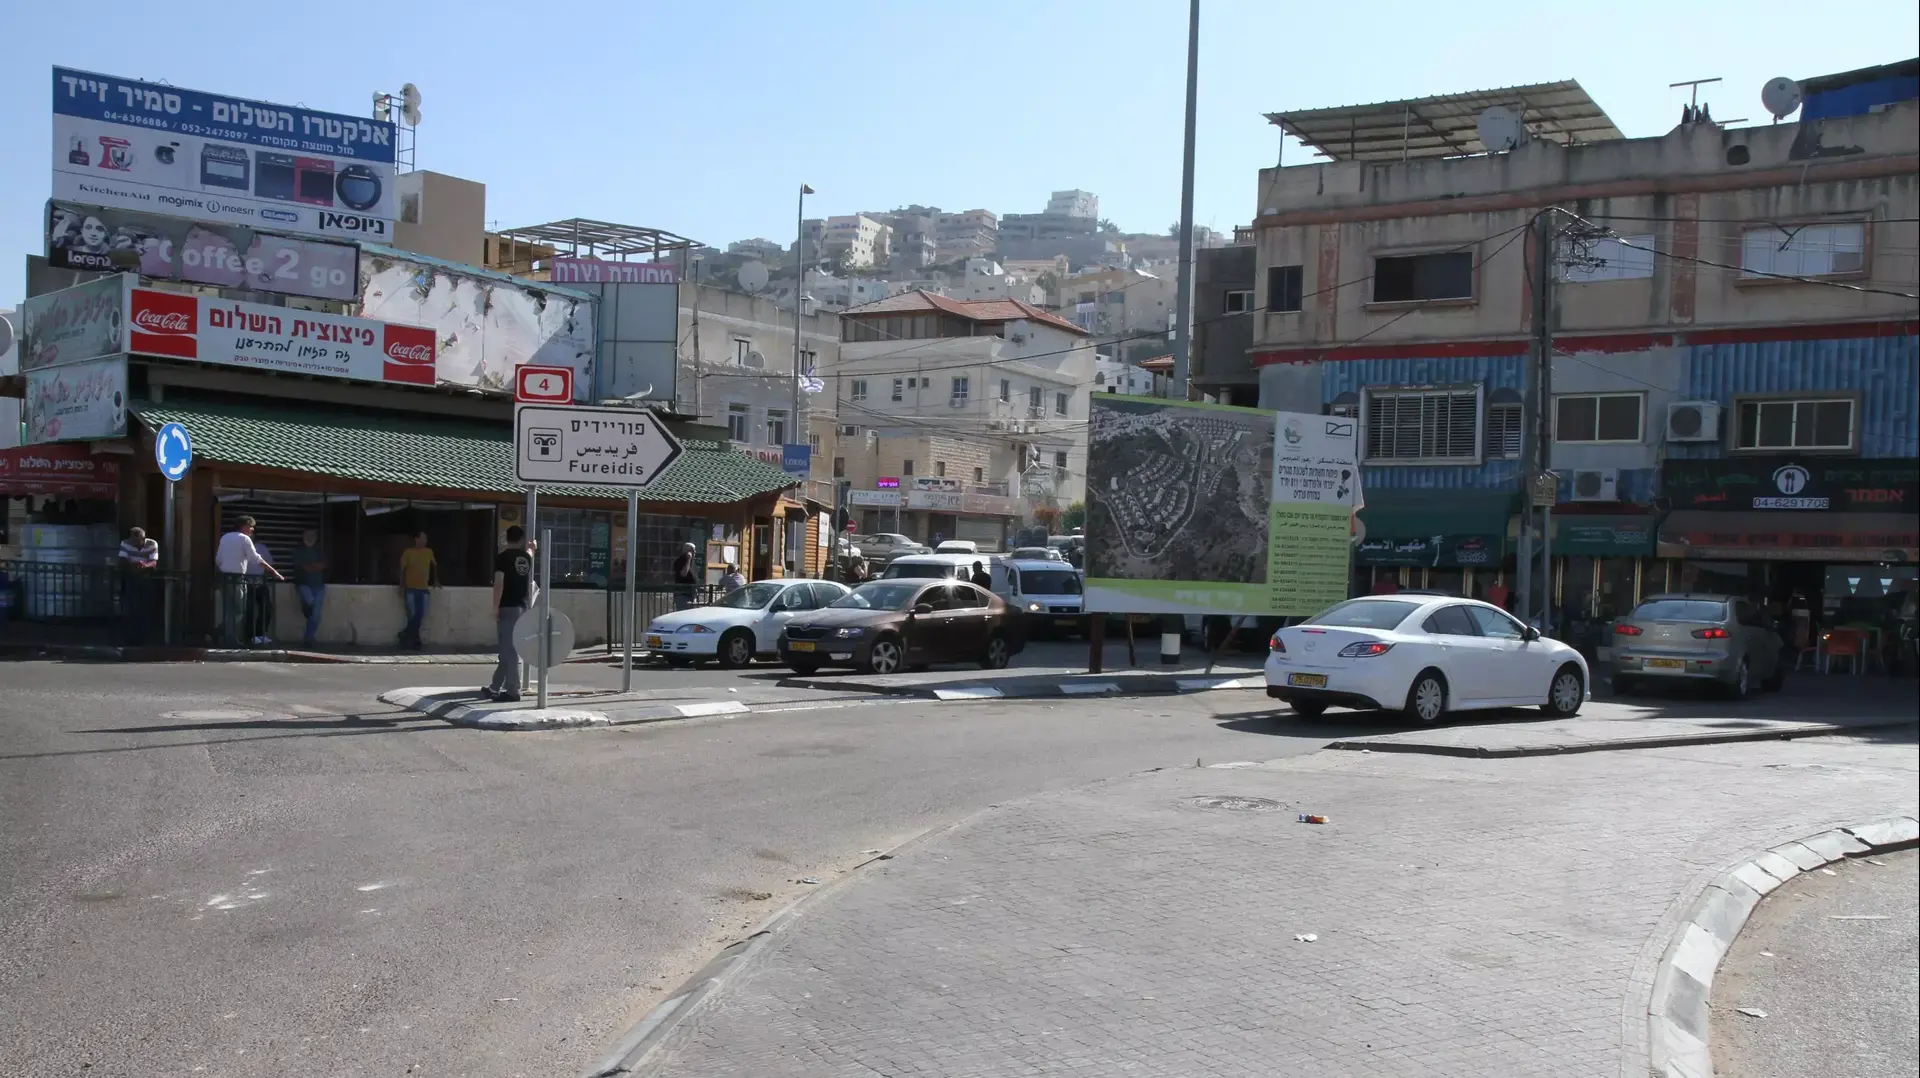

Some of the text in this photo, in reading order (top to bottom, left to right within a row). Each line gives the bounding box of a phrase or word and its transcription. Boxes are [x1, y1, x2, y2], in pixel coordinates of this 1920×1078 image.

[61, 75, 108, 103] זייד
[118, 85, 181, 114] סמיר
[103, 110, 168, 128] 04-6396886
[212, 101, 294, 133] השלום
[181, 123, 248, 140] 052-2475097
[303, 115, 390, 146] אלקטרו
[260, 134, 298, 149] מקומית
[337, 144, 354, 155] מול
[79, 183, 150, 201] KitchenAid
[158, 195, 204, 208] magimix
[319, 211, 385, 234] ניופאן
[276, 248, 299, 280] 2
[310, 266, 347, 286] go
[209, 304, 375, 346] פיצוצית השלום
[235, 336, 351, 364] זה הזמן להתרענן
[538, 378, 550, 391] 4
[571, 419, 645, 436] פוריידיס
[576, 442, 638, 459] فريديس
[19, 455, 52, 469] השלום
[569, 459, 644, 476] Fureidis
[1753, 498, 1829, 508] 04-6291708
